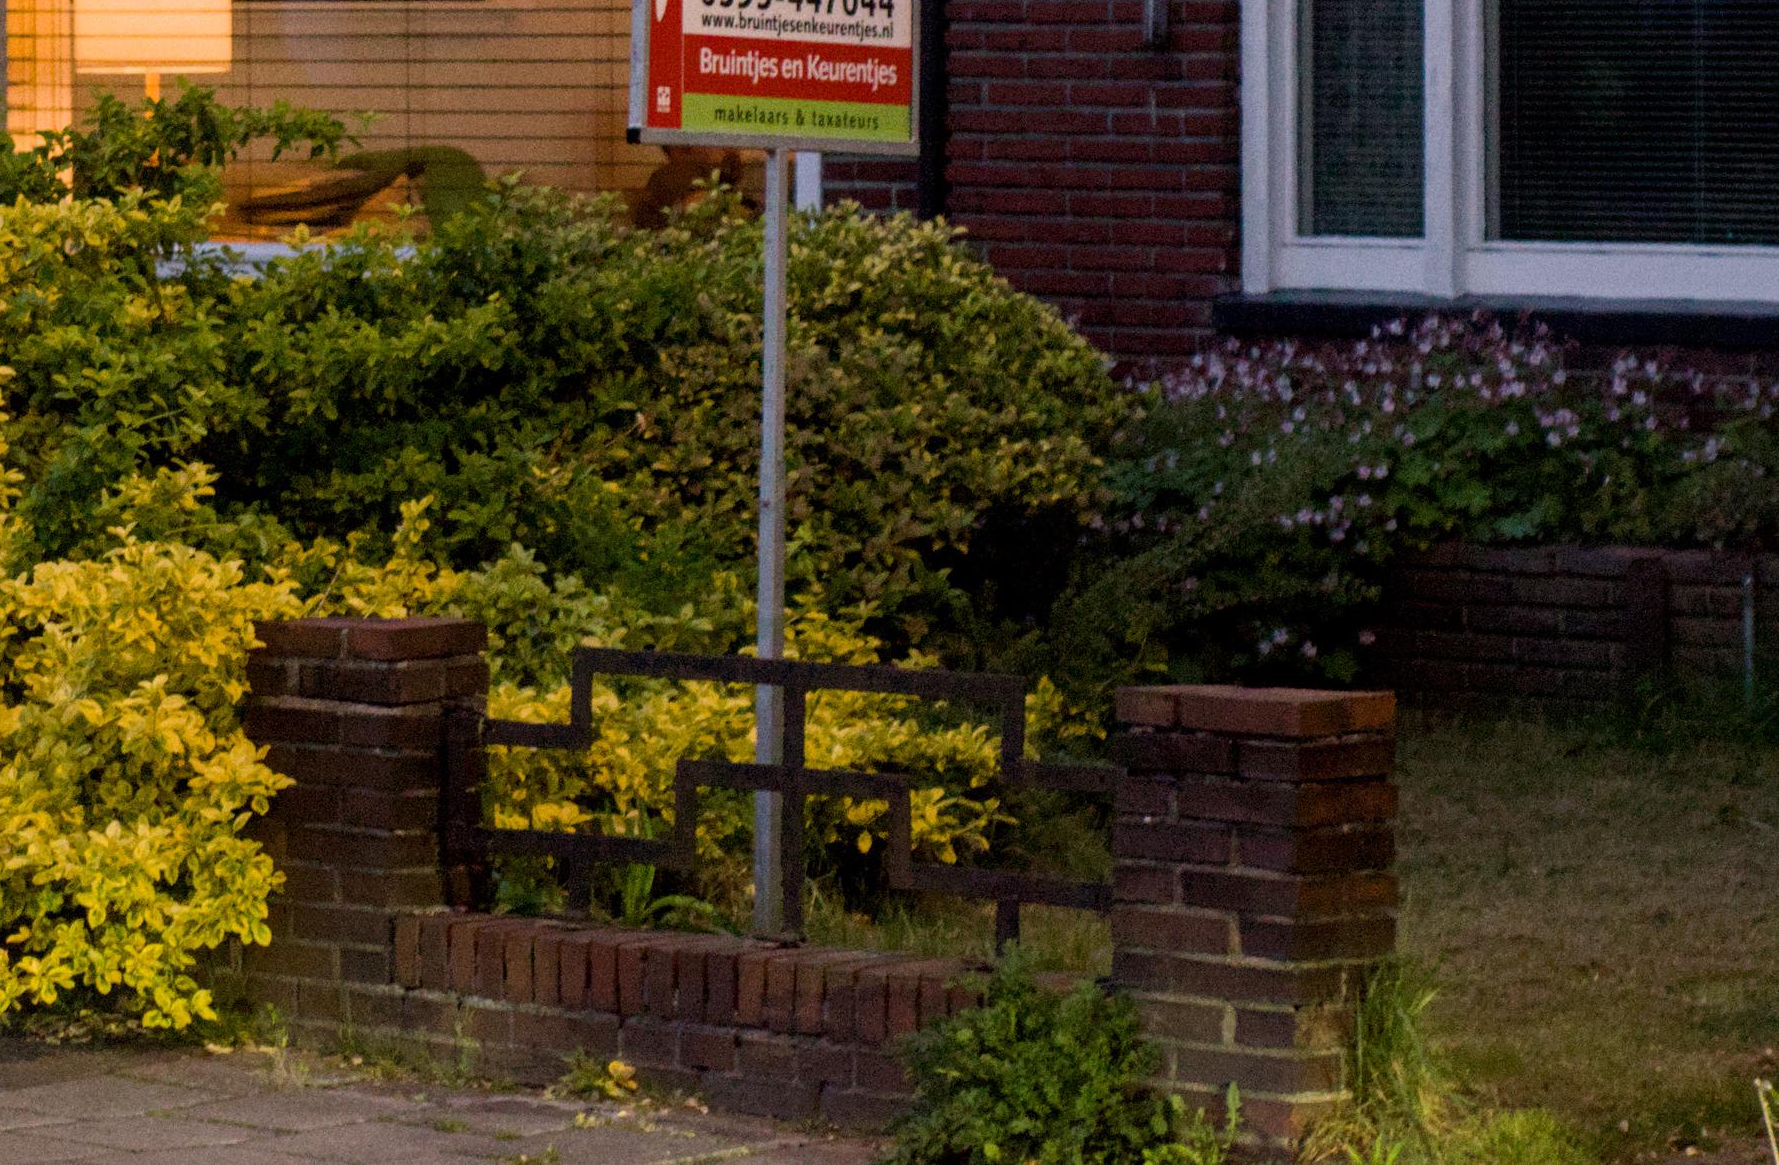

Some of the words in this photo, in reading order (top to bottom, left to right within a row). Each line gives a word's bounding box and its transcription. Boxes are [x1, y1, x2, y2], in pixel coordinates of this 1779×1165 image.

[701, 12, 895, 42] www.bruintjesenkeurentjes.nl
[699, 47, 779, 84] Bruintjes
[781, 57, 803, 78] en
[807, 55, 898, 91] Keurentjes
[714, 105, 789, 126] makelaars
[796, 109, 805, 126] &
[811, 108, 880, 131] taxateurs
